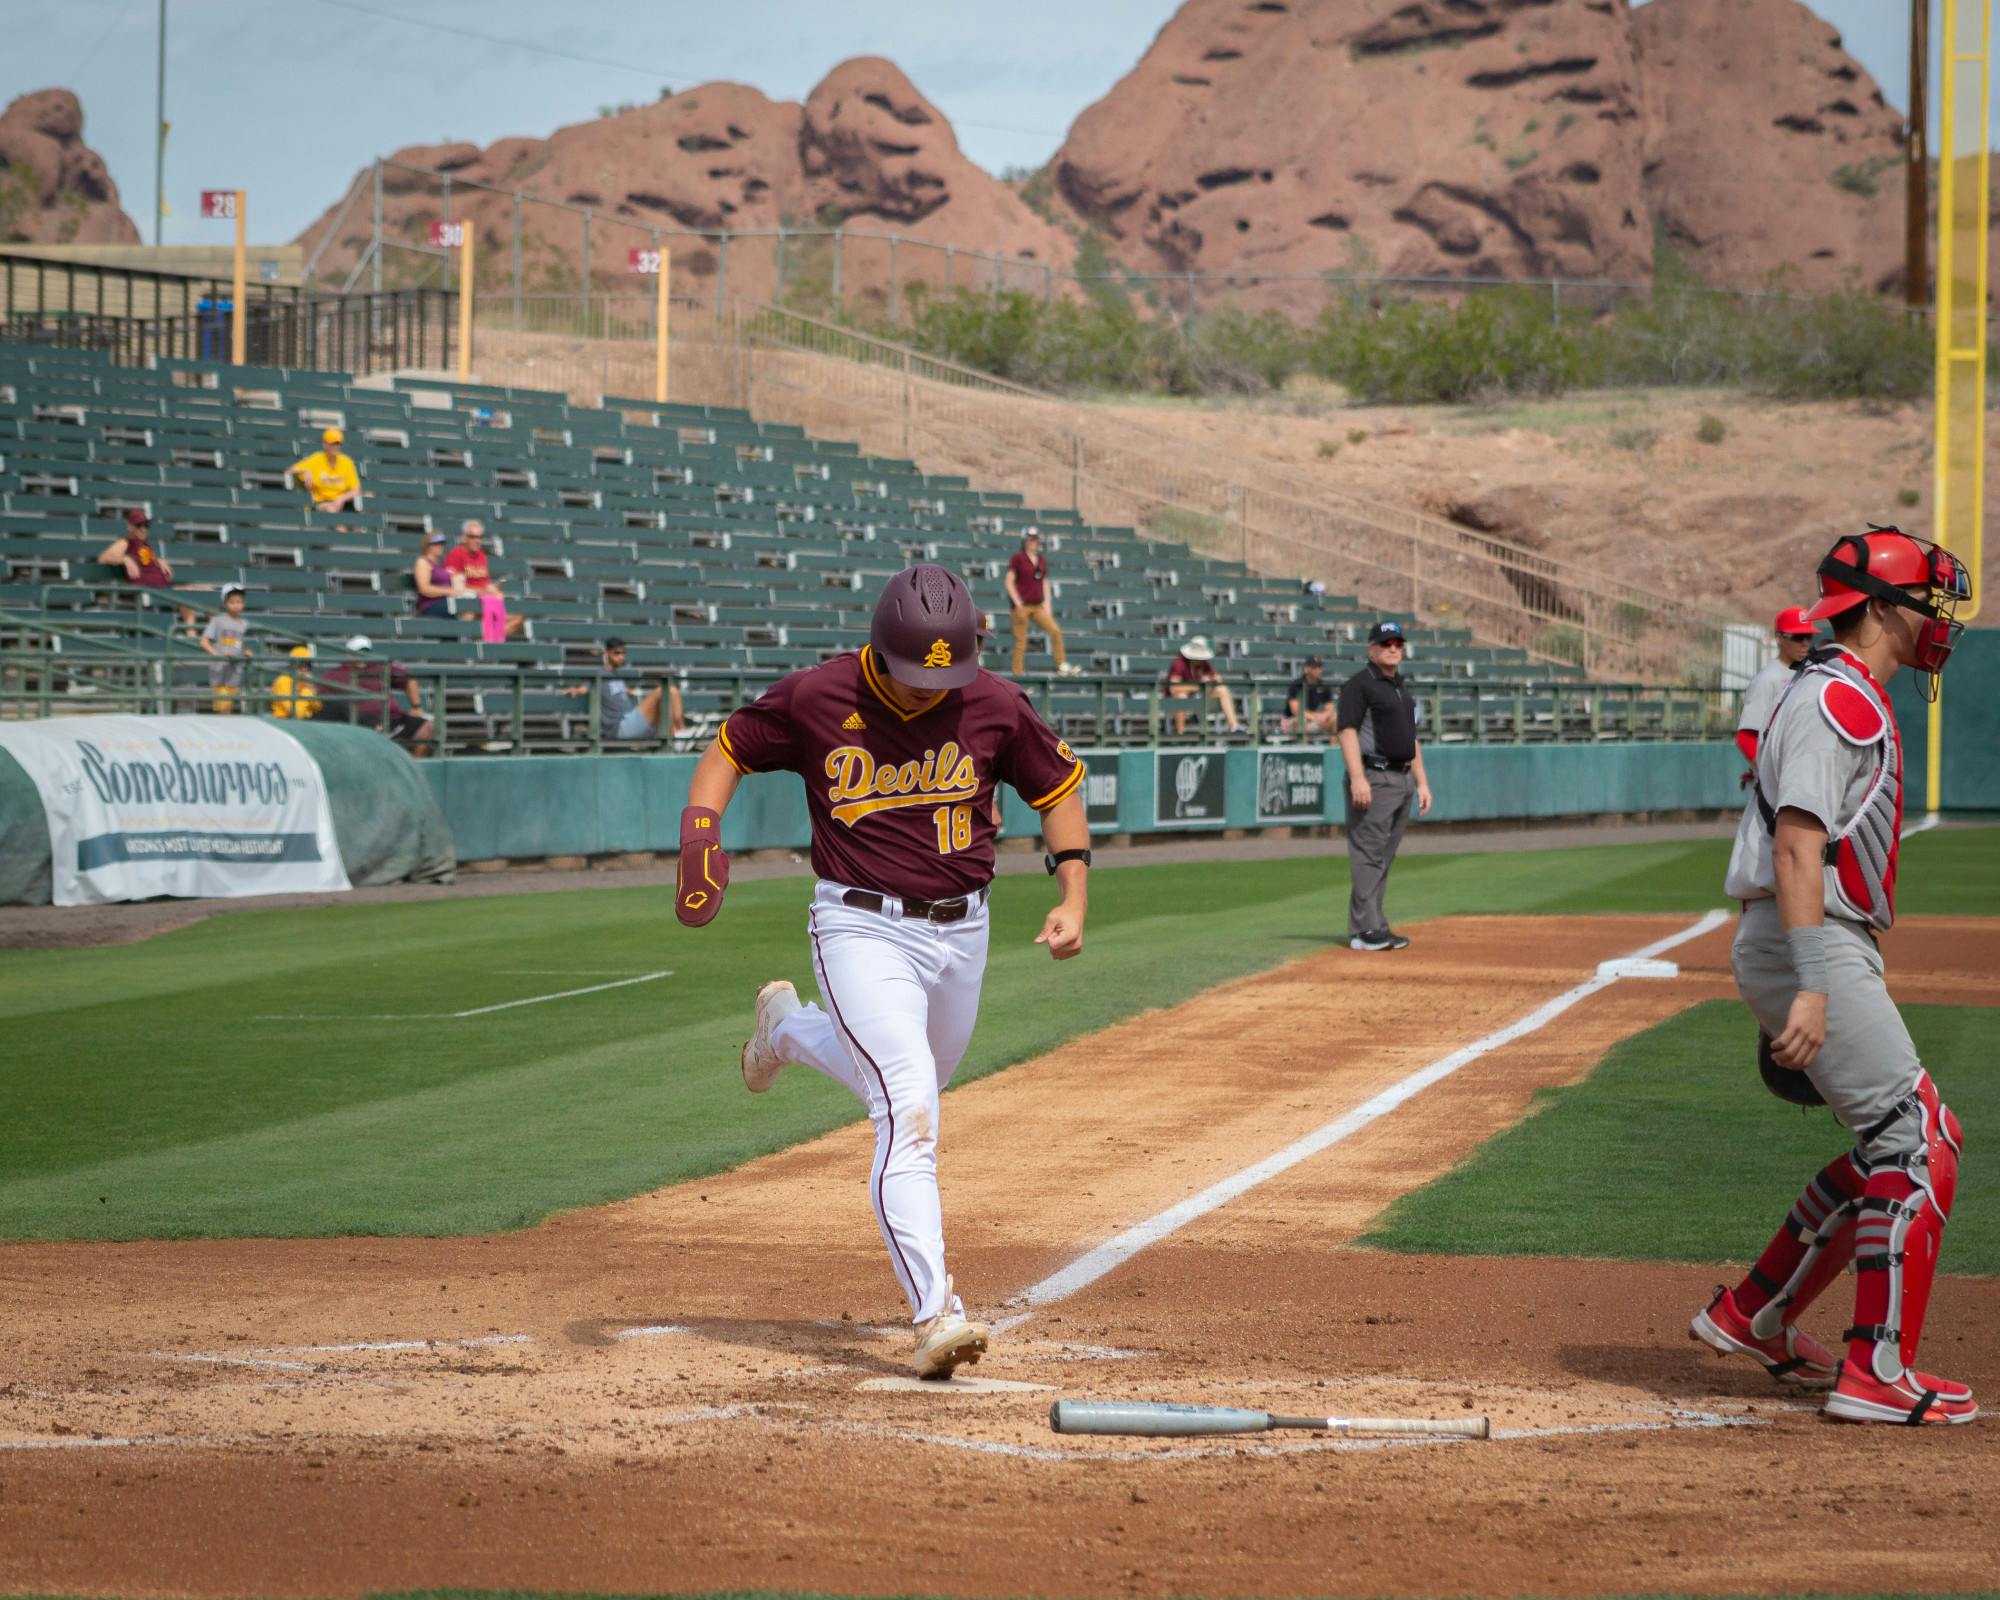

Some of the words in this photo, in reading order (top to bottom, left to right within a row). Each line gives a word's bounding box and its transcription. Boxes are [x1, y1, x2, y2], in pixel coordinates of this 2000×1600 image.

[438, 222, 464, 247] 30
[637, 250, 660, 273] 32
[841, 722, 867, 730] adidas
[76, 737, 287, 805] Someburros
[825, 741, 979, 802] Devils
[694, 817, 711, 829] 18
[933, 805, 972, 855] 18
